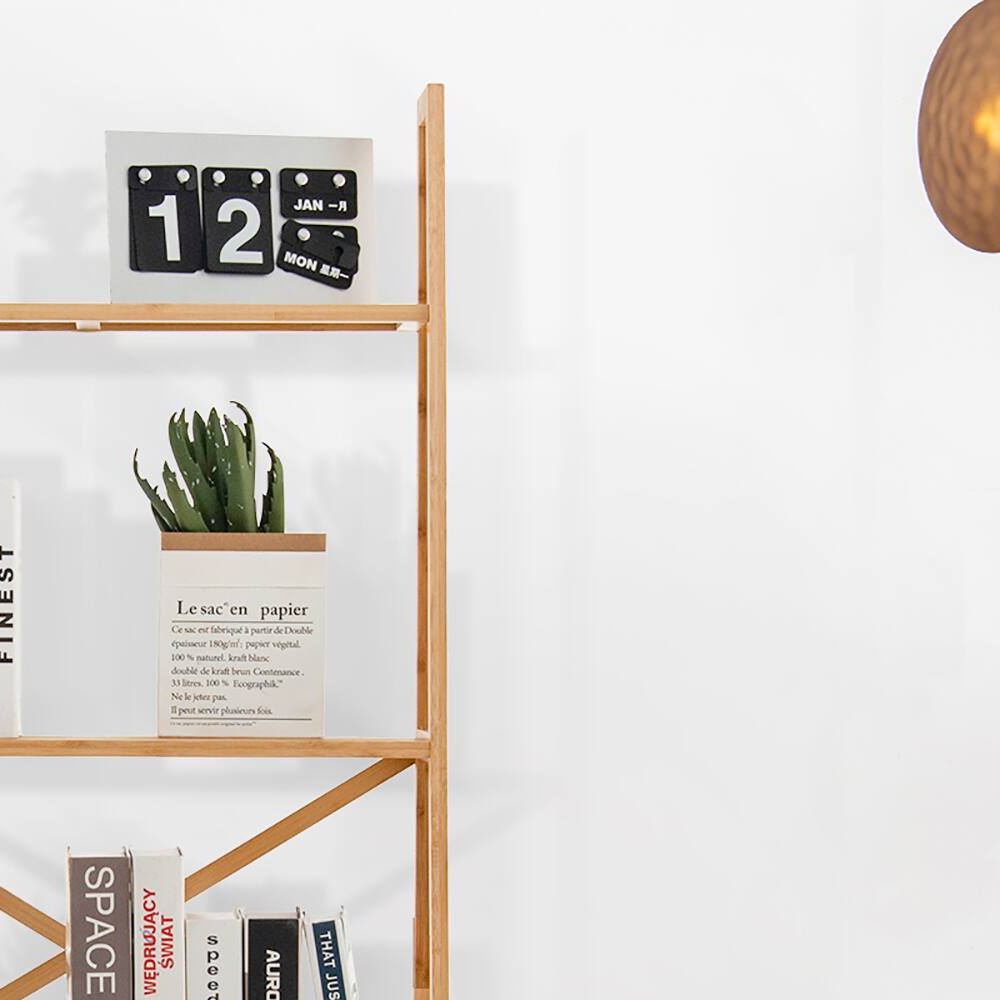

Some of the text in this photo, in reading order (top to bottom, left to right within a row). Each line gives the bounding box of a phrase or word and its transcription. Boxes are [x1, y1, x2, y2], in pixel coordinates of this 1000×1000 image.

[293, 200, 323, 212] JAN
[148, 195, 264, 265] 1 2
[284, 250, 318, 272] MON
[177, 600, 198, 615] Le
[230, 606, 247, 615] en
[261, 602, 309, 620] papier
[171, 625, 183, 633] Ce
[250, 626, 273, 636] partir
[273, 626, 284, 634] de
[284, 626, 313, 635] Double
[245, 641, 270, 650] papier
[171, 654, 186, 662] 100
[228, 653, 247, 662] kraft
[248, 653, 270, 662] blanc
[200, 667, 211, 675] de
[211, 667, 230, 675] kraft
[231, 667, 251, 676] brun
[171, 693, 183, 701] Ne
[184, 692, 192, 701] le
[178, 707, 196, 716] peut
[197, 707, 220, 715] servir
[221, 706, 256, 717] plusieurs
[85, 866, 116, 995] SPACE
[319, 930, 337, 968] THAT
